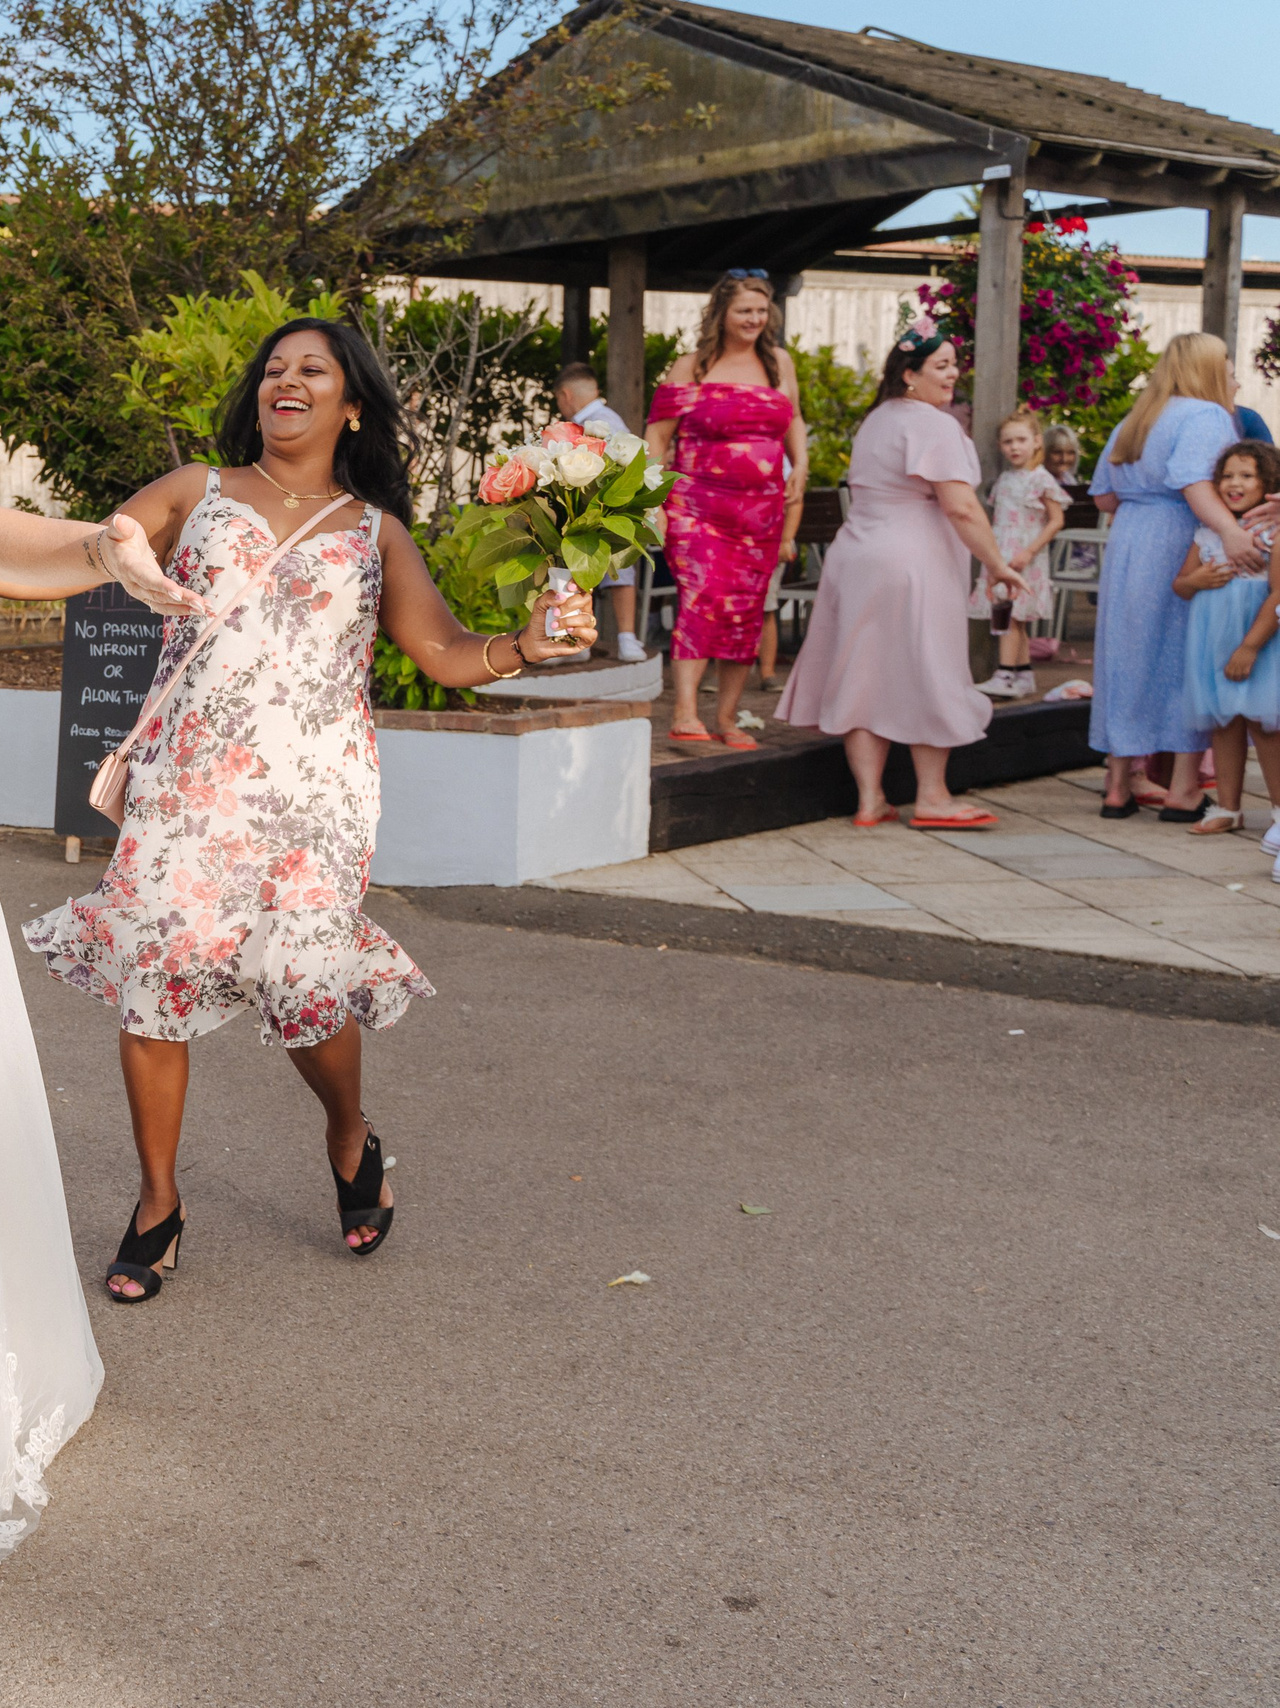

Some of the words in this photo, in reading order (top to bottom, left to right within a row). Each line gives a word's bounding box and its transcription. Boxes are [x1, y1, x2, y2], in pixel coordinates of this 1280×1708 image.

[75, 620, 98, 640] NO
[89, 643, 148, 657] INFRONT
[103, 664, 124, 679] OR
[81, 686, 121, 706] ALONG
